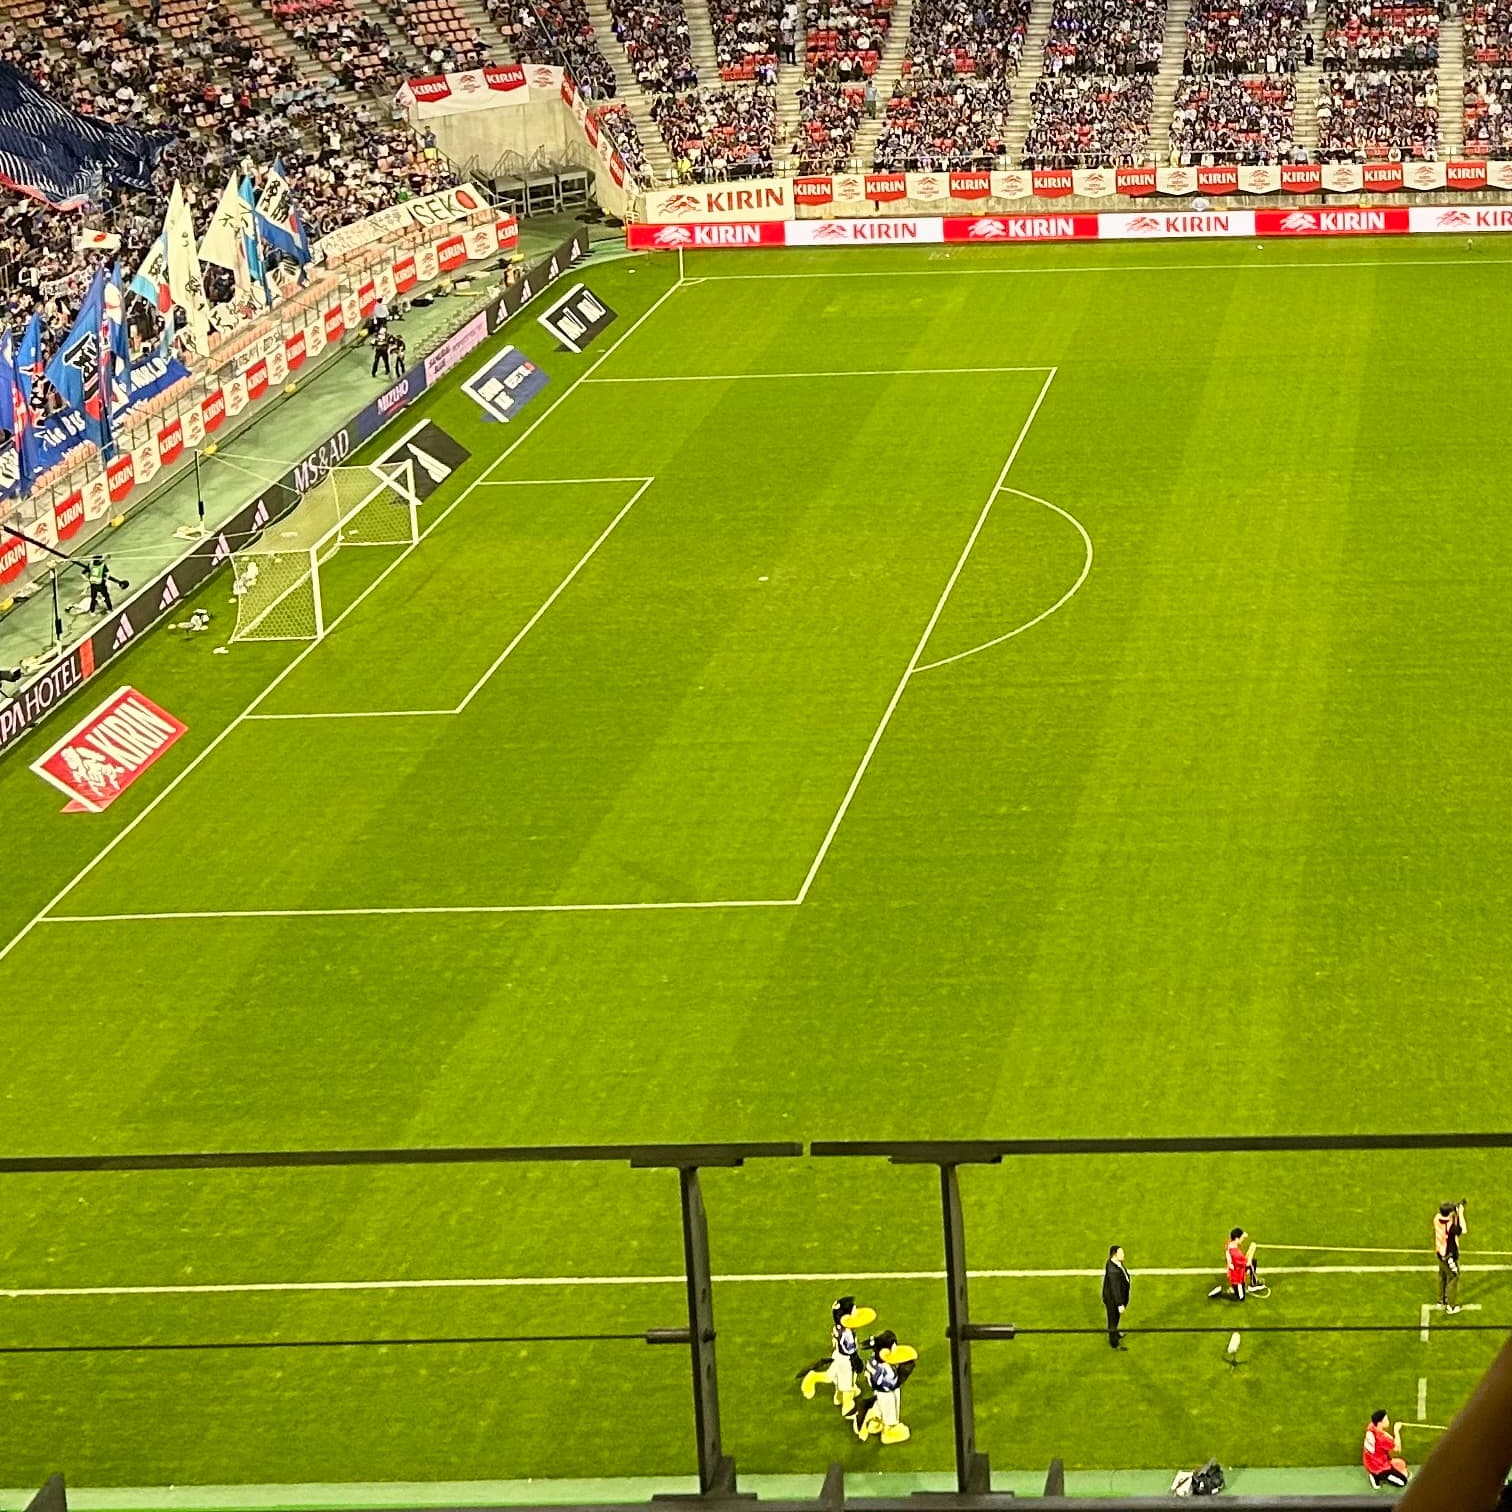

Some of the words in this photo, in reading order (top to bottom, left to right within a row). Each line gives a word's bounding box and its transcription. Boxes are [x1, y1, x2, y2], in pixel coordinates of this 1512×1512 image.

[487, 71, 523, 84] KIRIN
[410, 81, 449, 97] KIRIN
[1117, 174, 1156, 187] KIRIN
[1198, 172, 1237, 185] KIRIN
[1282, 170, 1320, 183] KIRIN
[1364, 169, 1402, 182] KIRIN
[1447, 167, 1486, 179] KIRIN
[793, 183, 831, 196] KIRIN
[866, 180, 905, 193] KIRIN
[950, 178, 989, 191] KIRIN
[1033, 176, 1072, 189] KIRIN
[706, 186, 785, 214] KIRIN
[1008, 219, 1075, 238] KIRIN
[1165, 215, 1229, 232] KIRIN
[1320, 212, 1386, 231] KIRIN
[693, 225, 762, 245] KIRIN
[852, 223, 917, 240] KIRIN
[378, 379, 409, 416] MIZUNO
[294, 429, 349, 492] MS&AD
[109, 464, 134, 491] KIRIN
[57, 501, 84, 532] KIRIN
[0, 541, 26, 574] KIRIN
[0, 701, 26, 746] PA
[25, 656, 82, 722] HOTEL
